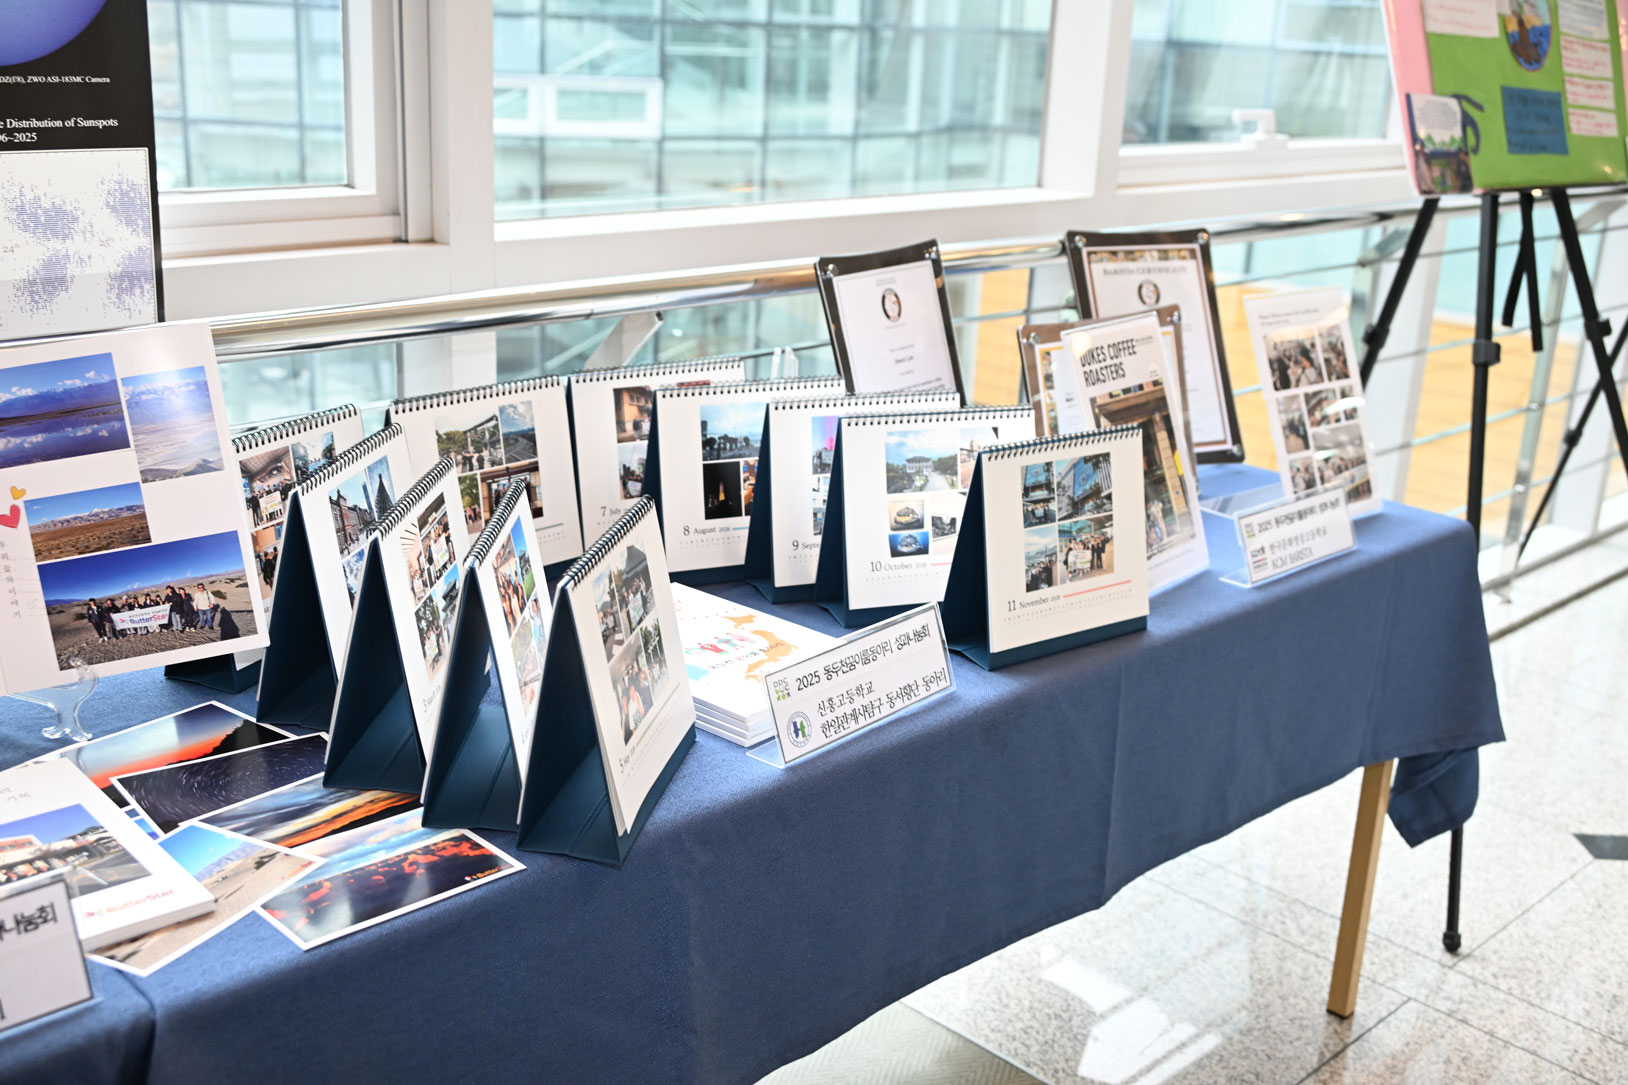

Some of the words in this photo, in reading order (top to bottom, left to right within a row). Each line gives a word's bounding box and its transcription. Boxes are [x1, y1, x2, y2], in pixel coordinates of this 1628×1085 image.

[27, 75, 46, 83] ZWO
[47, 75, 85, 83] ASI-183MC
[86, 75, 111, 83] Camera
[6, 117, 63, 129] Distribution
[65, 117, 76, 127] of
[77, 117, 119, 129] Sunspots
[0, 132, 38, 142] 6~2025
[1080, 345, 1107, 367] DUKES
[1107, 338, 1137, 360] COFFEE
[1083, 361, 1126, 388] ROASTERS
[600, 506, 607, 517] 7
[683, 525, 690, 536] 8
[693, 527, 717, 536] August
[792, 540, 799, 550] 9
[870, 561, 882, 573] 10
[883, 562, 912, 572] October
[1007, 600, 1017, 612] 11
[1019, 596, 1050, 609] November
[795, 670, 821, 692] 2025
[823, 639, 894, 681] 동두천꿈이룸동아리
[894, 623, 931, 651] 성과나눔회
[817, 681, 876, 717] 신흥고등학교
[820, 698, 885, 739] 한일관계사탐구
[922, 668, 948, 693] 동아리
